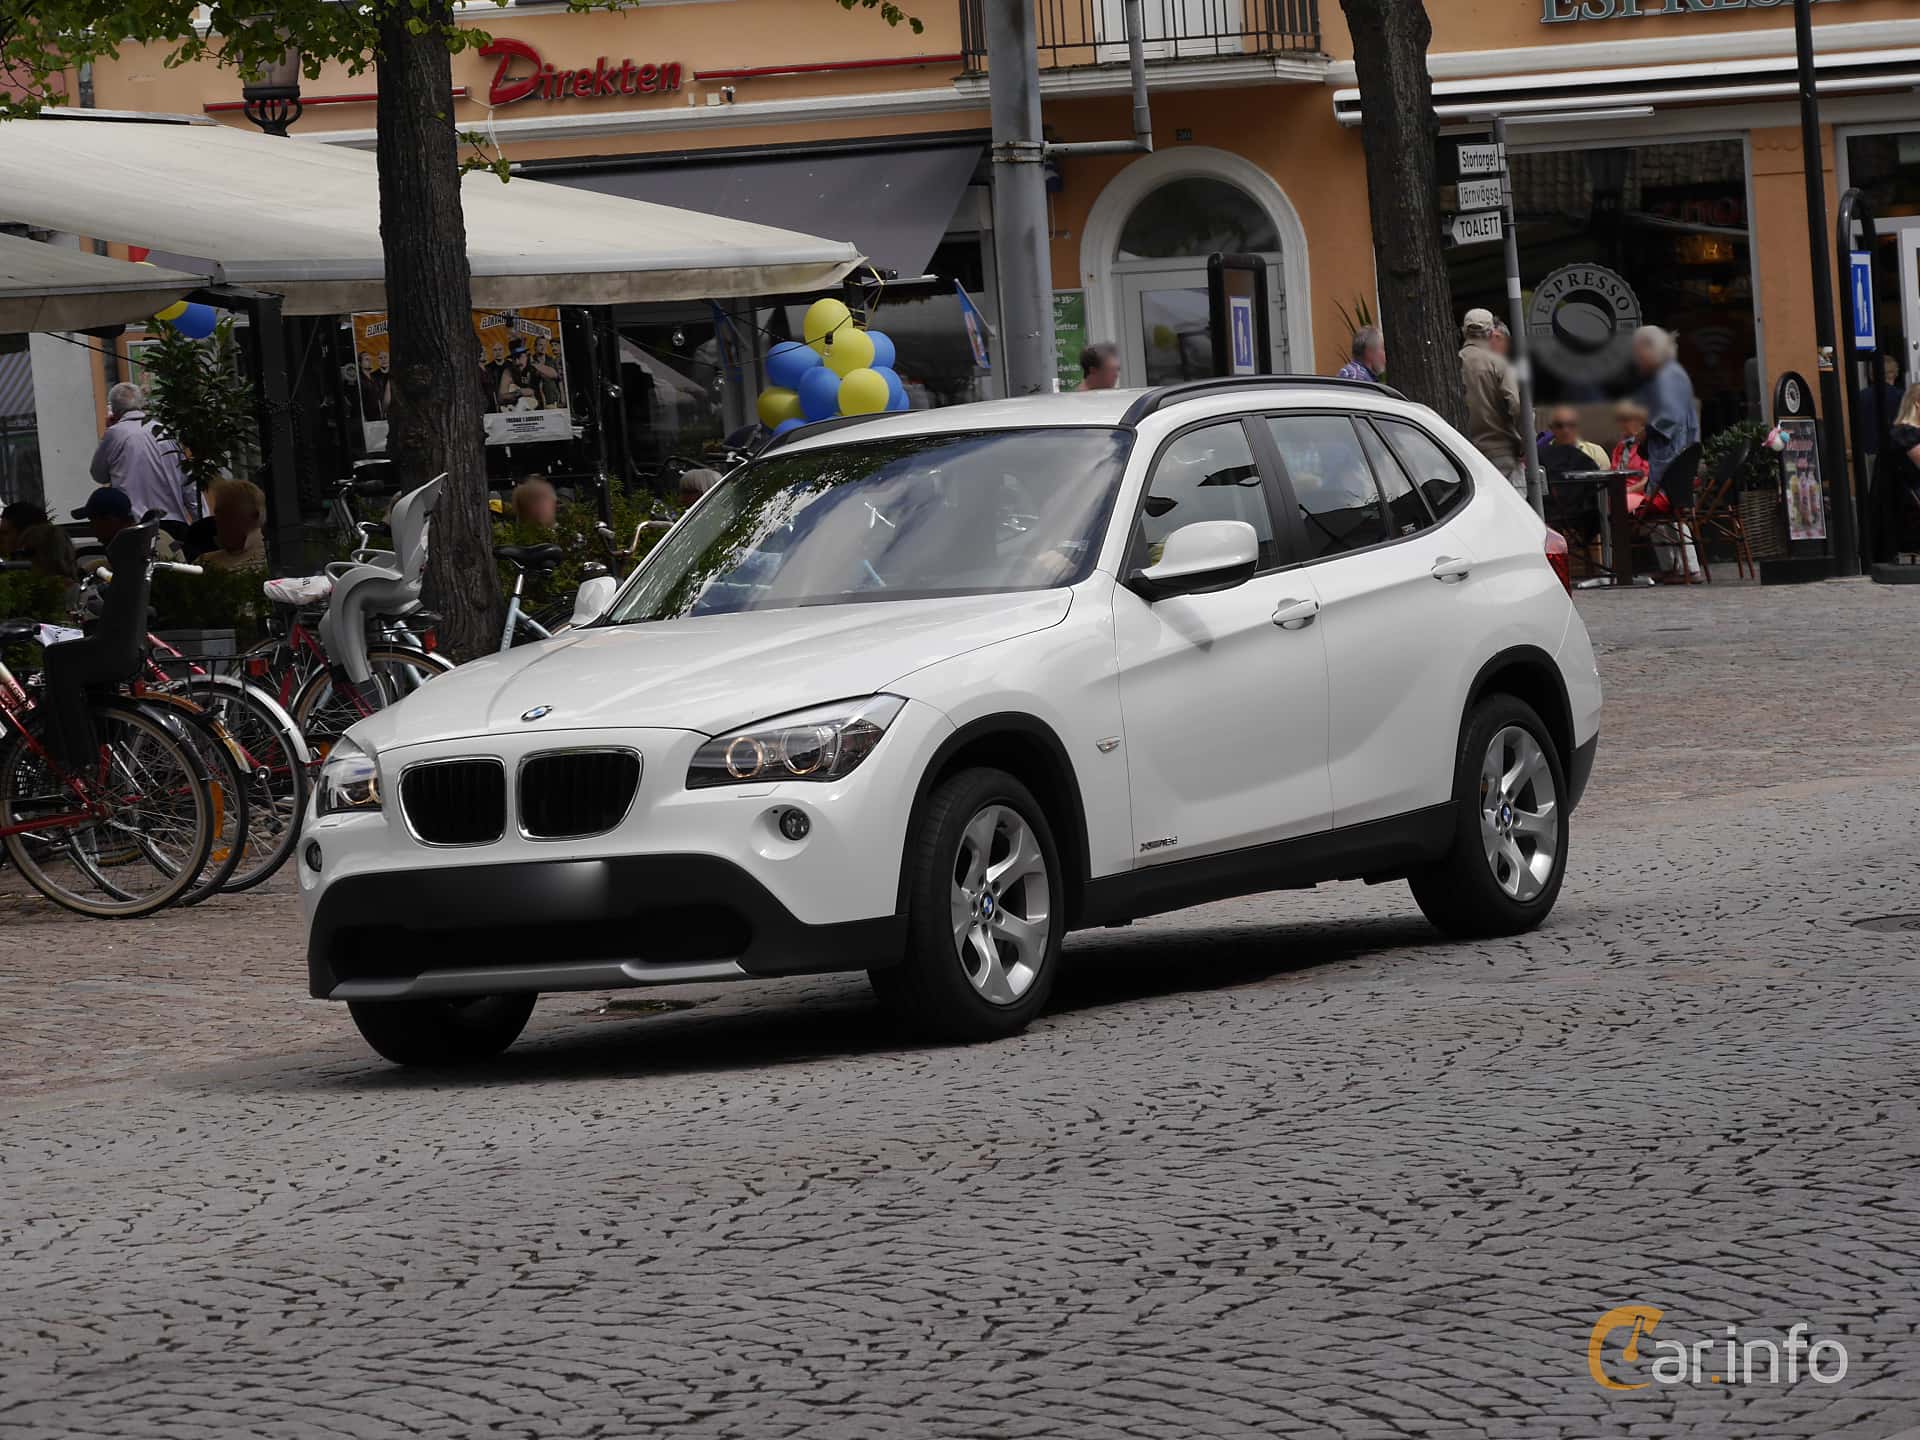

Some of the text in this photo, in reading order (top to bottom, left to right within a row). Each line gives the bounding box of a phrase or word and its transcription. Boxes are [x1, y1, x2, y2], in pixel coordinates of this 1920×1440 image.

[478, 37, 682, 105] Direkten
[1462, 151, 1497, 170] Stortorget
[1460, 216, 1499, 238] TOALETT
[1536, 271, 1631, 314] ESPRESSO
